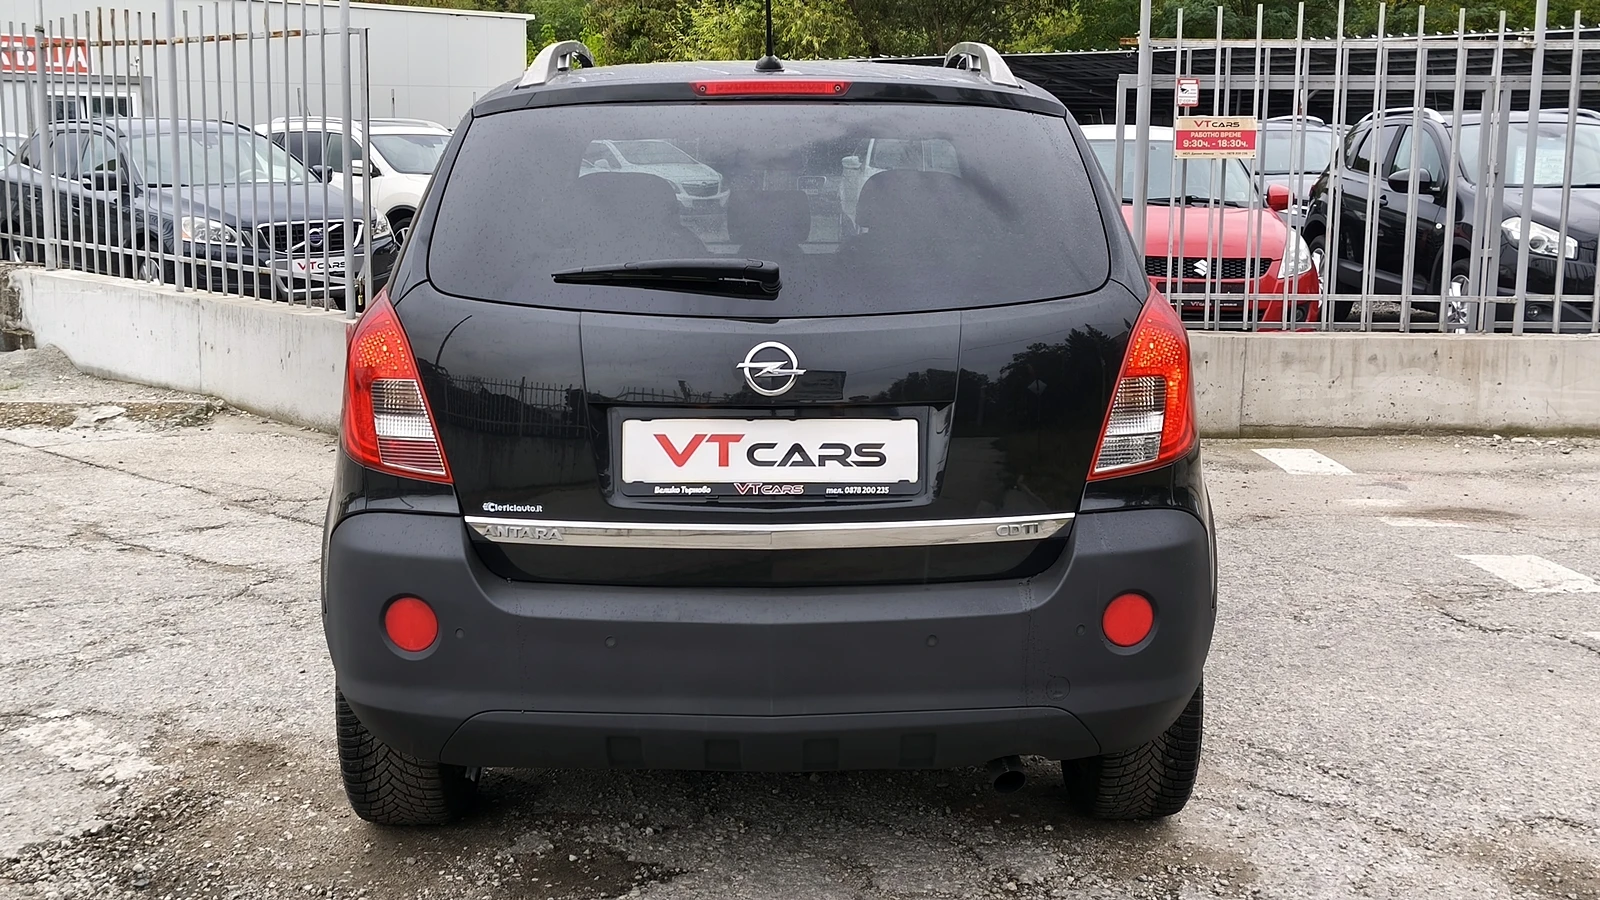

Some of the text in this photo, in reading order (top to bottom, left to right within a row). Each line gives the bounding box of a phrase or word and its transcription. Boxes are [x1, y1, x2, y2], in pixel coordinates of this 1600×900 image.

[1182, 139, 1210, 147] 9:30ч.
[1217, 139, 1248, 147] 18:30ч.
[844, 486, 862, 494] 0878
[861, 486, 876, 494] 200
[483, 525, 564, 541] ANTARA
[996, 522, 1039, 537] CDTI
